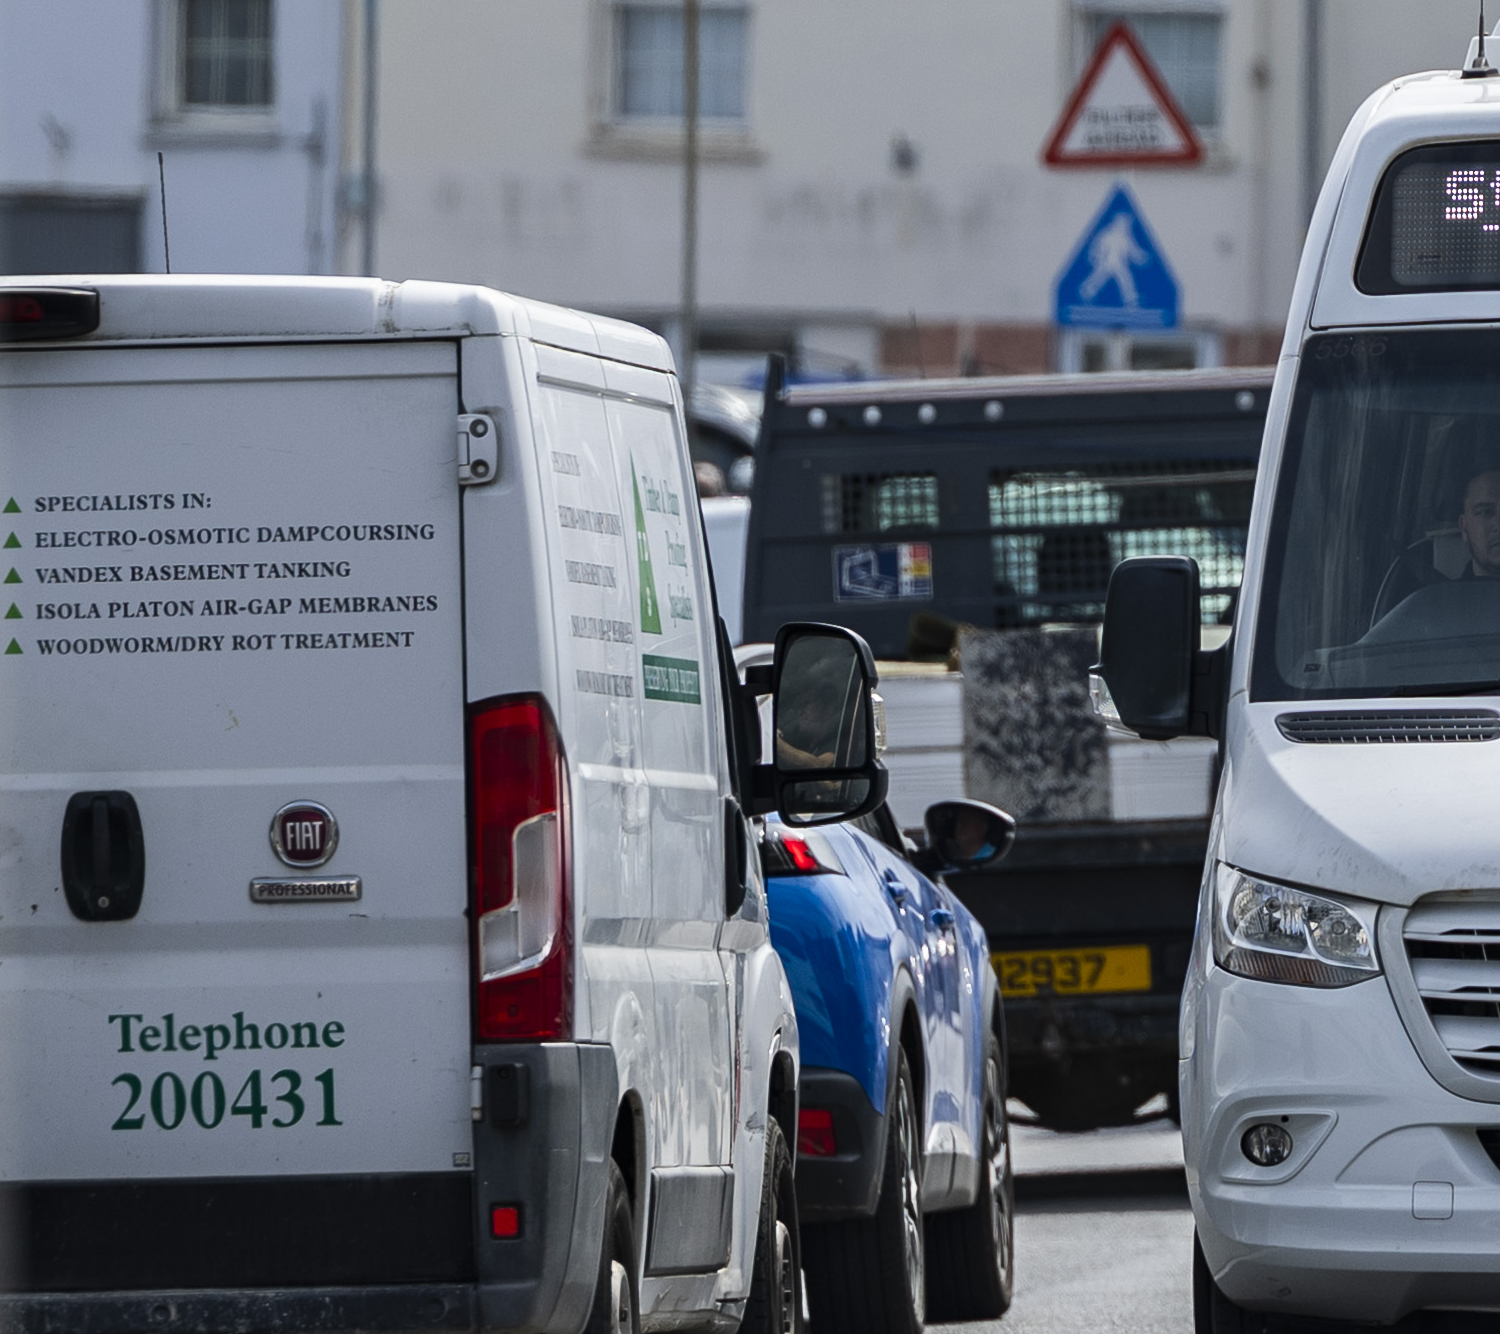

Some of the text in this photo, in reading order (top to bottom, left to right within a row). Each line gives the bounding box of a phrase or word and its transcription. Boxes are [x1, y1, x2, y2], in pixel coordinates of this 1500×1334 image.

[34, 492, 213, 513] SPECIALISTS IN:
[34, 523, 436, 549] ELECTRO-OSMOTIC DAMPCOURSING
[35, 560, 351, 584] VANDEX BASEMENT TANKING
[35, 594, 439, 620] ISOLA PLATON AIR-GAP MEMBRANES
[36, 630, 415, 656] WOODWORM/DRY ROT TREATMENT
[285, 821, 323, 851] FIAT
[258, 882, 354, 897] PROFESSIONAL
[108, 1011, 346, 1060] Telephone
[110, 1067, 344, 1131] 200431
